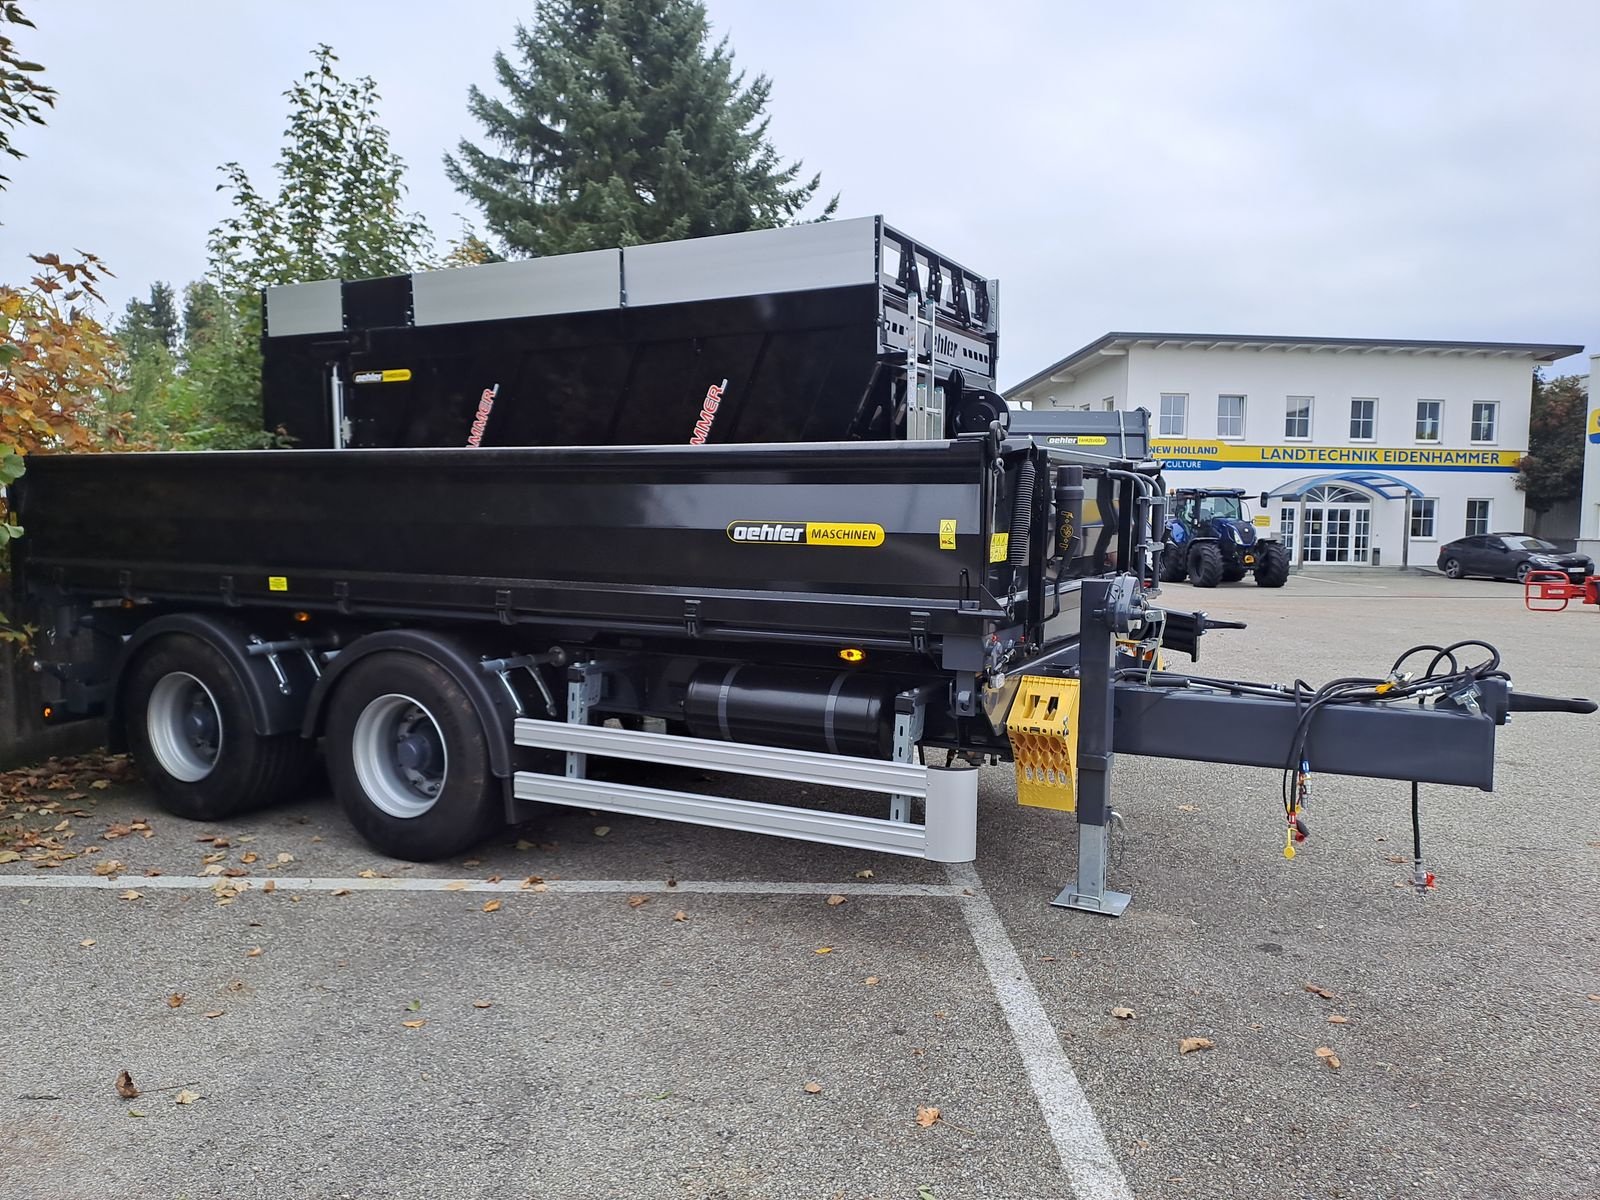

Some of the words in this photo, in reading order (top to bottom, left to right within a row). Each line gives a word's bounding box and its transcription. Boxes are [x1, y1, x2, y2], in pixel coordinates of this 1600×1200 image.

[1049, 436, 1077, 444] oehler
[1150, 445, 1171, 454] NEW
[1173, 446, 1218, 455] HOLLAND
[1260, 447, 1378, 462] LANDTECHNIK
[1383, 449, 1500, 464] EIDENHAMMER
[733, 523, 804, 542] oehler
[811, 528, 877, 541] MASCHINEN
